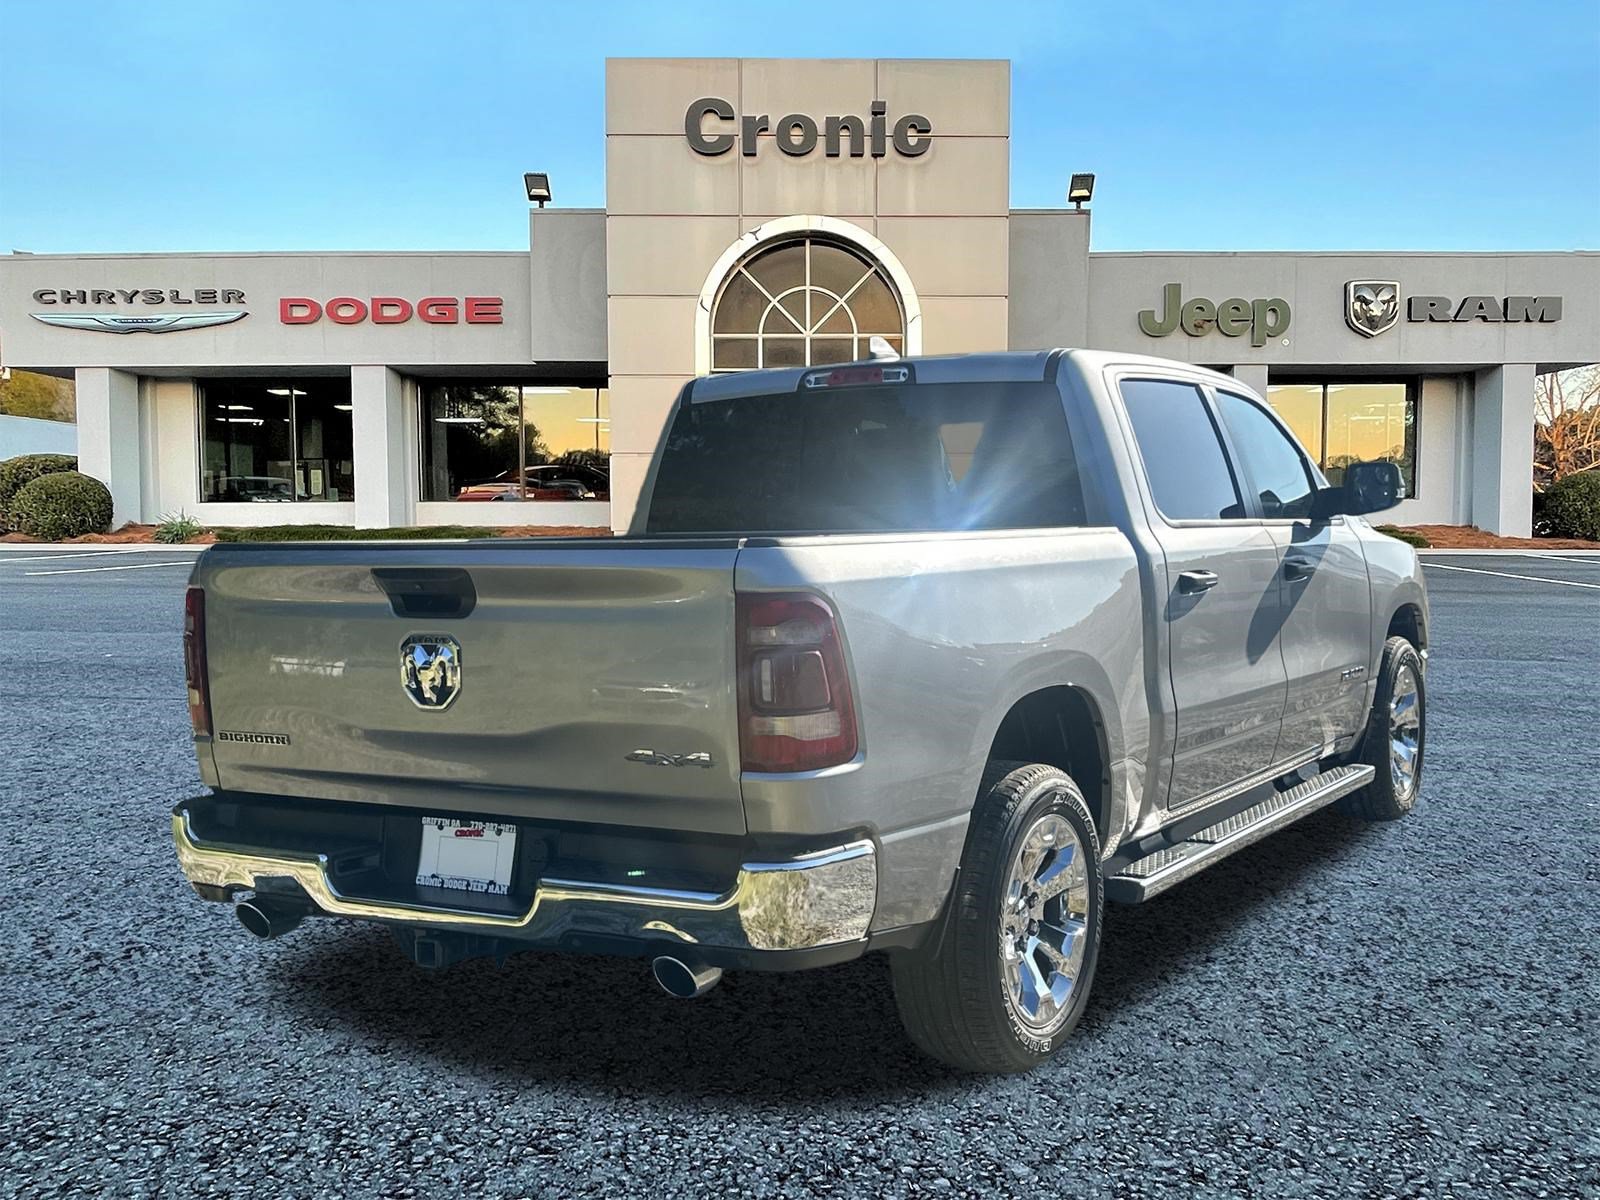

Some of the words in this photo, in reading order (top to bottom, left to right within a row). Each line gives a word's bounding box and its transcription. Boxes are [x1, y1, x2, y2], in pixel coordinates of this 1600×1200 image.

[685, 96, 932, 158] Cronic
[32, 288, 246, 305] CHRYSLER
[1407, 295, 1563, 323] RAM
[279, 297, 503, 325] DODGE
[1138, 282, 1292, 348] Jeep
[218, 731, 287, 746] BIGHORN
